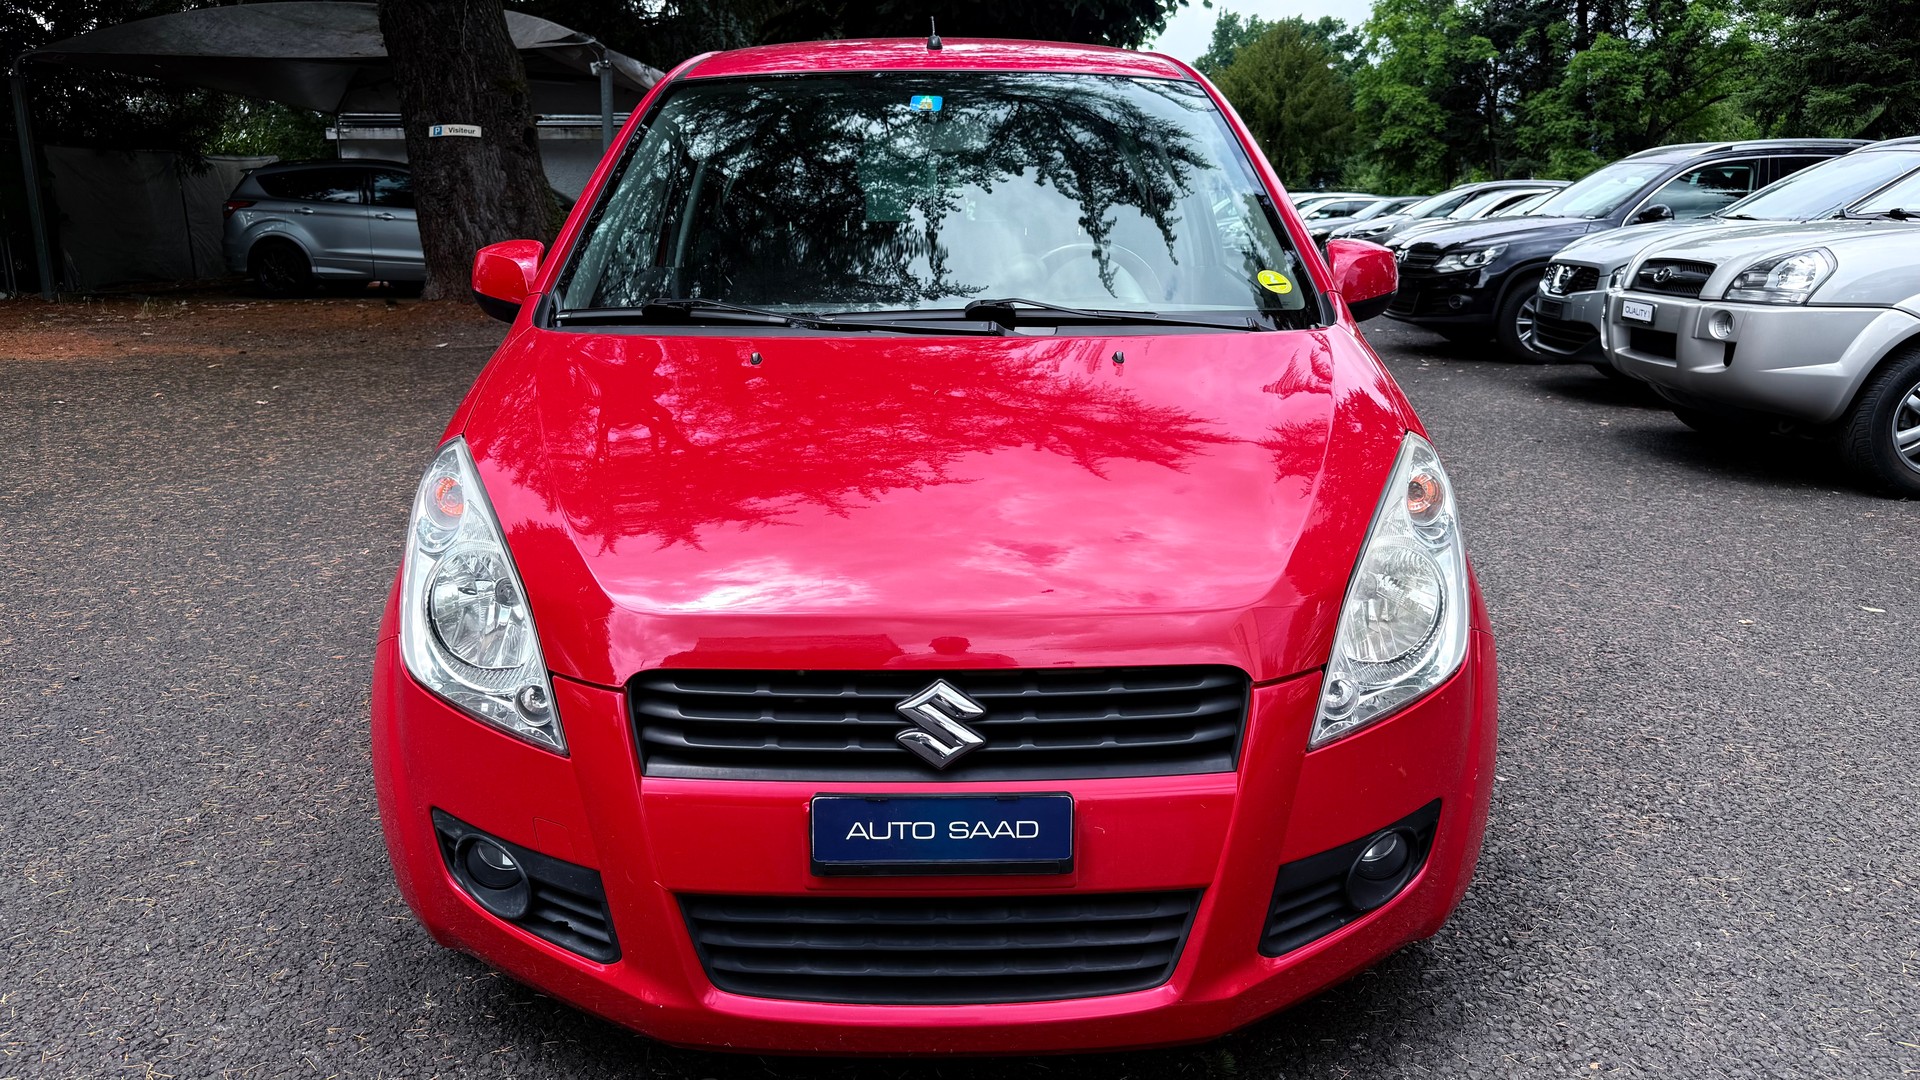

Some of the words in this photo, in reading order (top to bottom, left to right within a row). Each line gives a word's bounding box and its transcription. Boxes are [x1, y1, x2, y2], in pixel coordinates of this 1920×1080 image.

[448, 127, 476, 135] Visiteur
[846, 822, 935, 840] AUTO
[949, 821, 1039, 839] SAAD
